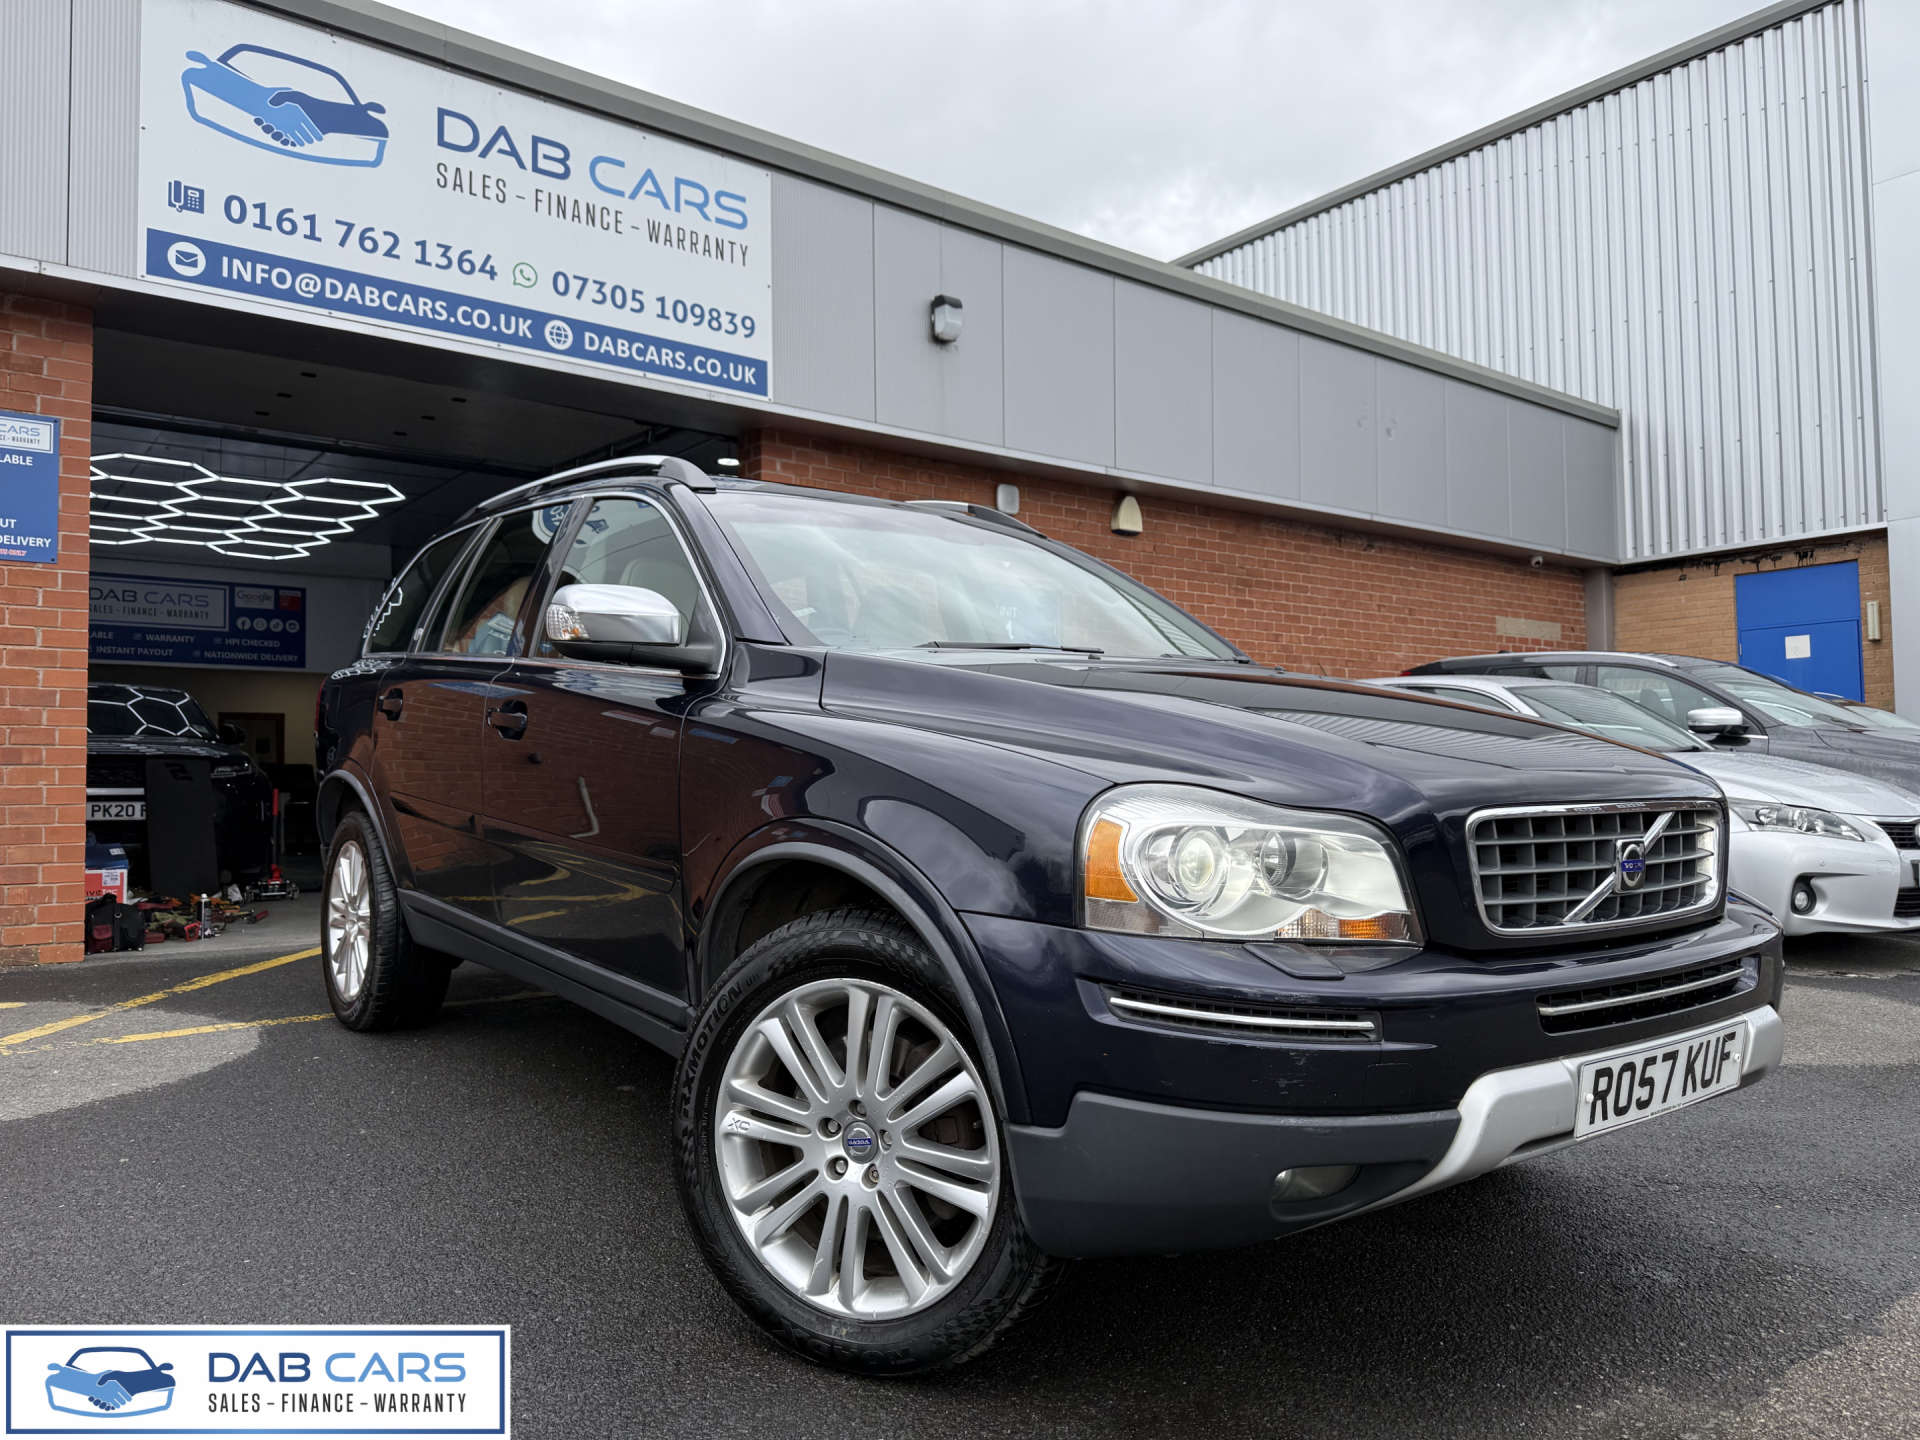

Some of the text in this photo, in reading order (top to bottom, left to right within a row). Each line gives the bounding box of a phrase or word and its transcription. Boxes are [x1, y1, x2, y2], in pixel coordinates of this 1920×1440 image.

[437, 106, 749, 230] DAB CARS
[223, 194, 498, 281] 0161 762 1364
[436, 162, 507, 204] SALES
[534, 188, 624, 235] FINANCE
[646, 217, 749, 267] WARRANTY
[221, 255, 532, 339] INFO@DABCARS.CO.UK
[552, 270, 756, 338] 07305 109839
[583, 331, 757, 385] DABCARS.CO.UK
[90, 604, 113, 615] ALES
[144, 591, 209, 608] CARS
[96, 645, 299, 663] INSTANT PAYOUT NATIONWIDE DELIVERY
[145, 632, 196, 644] WARRANTY
[91, 804, 135, 818] PK20
[1589, 1030, 1736, 1125] RO57 KUF
[728, 1117, 751, 1131] XC
